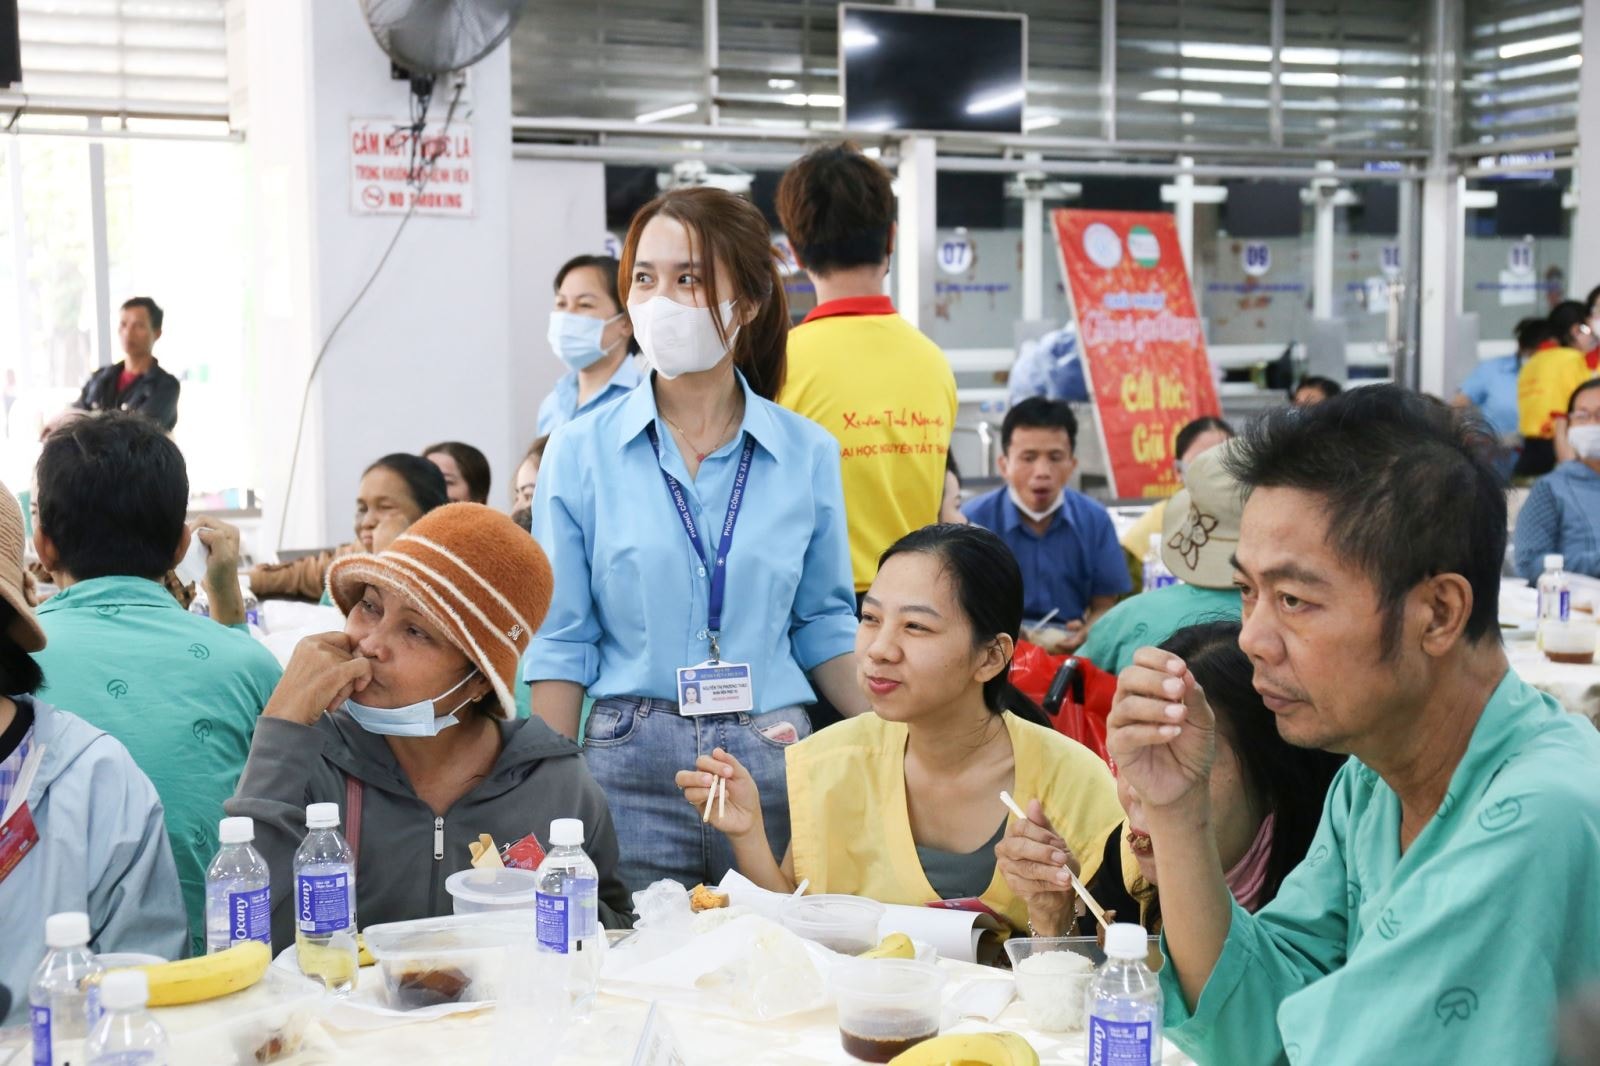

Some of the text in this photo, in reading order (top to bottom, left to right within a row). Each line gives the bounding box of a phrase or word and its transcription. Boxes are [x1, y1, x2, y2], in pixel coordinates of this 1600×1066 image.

[389, 192, 404, 207] NO
[943, 242, 967, 265] 07
[302, 879, 313, 921] Ocany
[235, 896, 249, 939] Ocany
